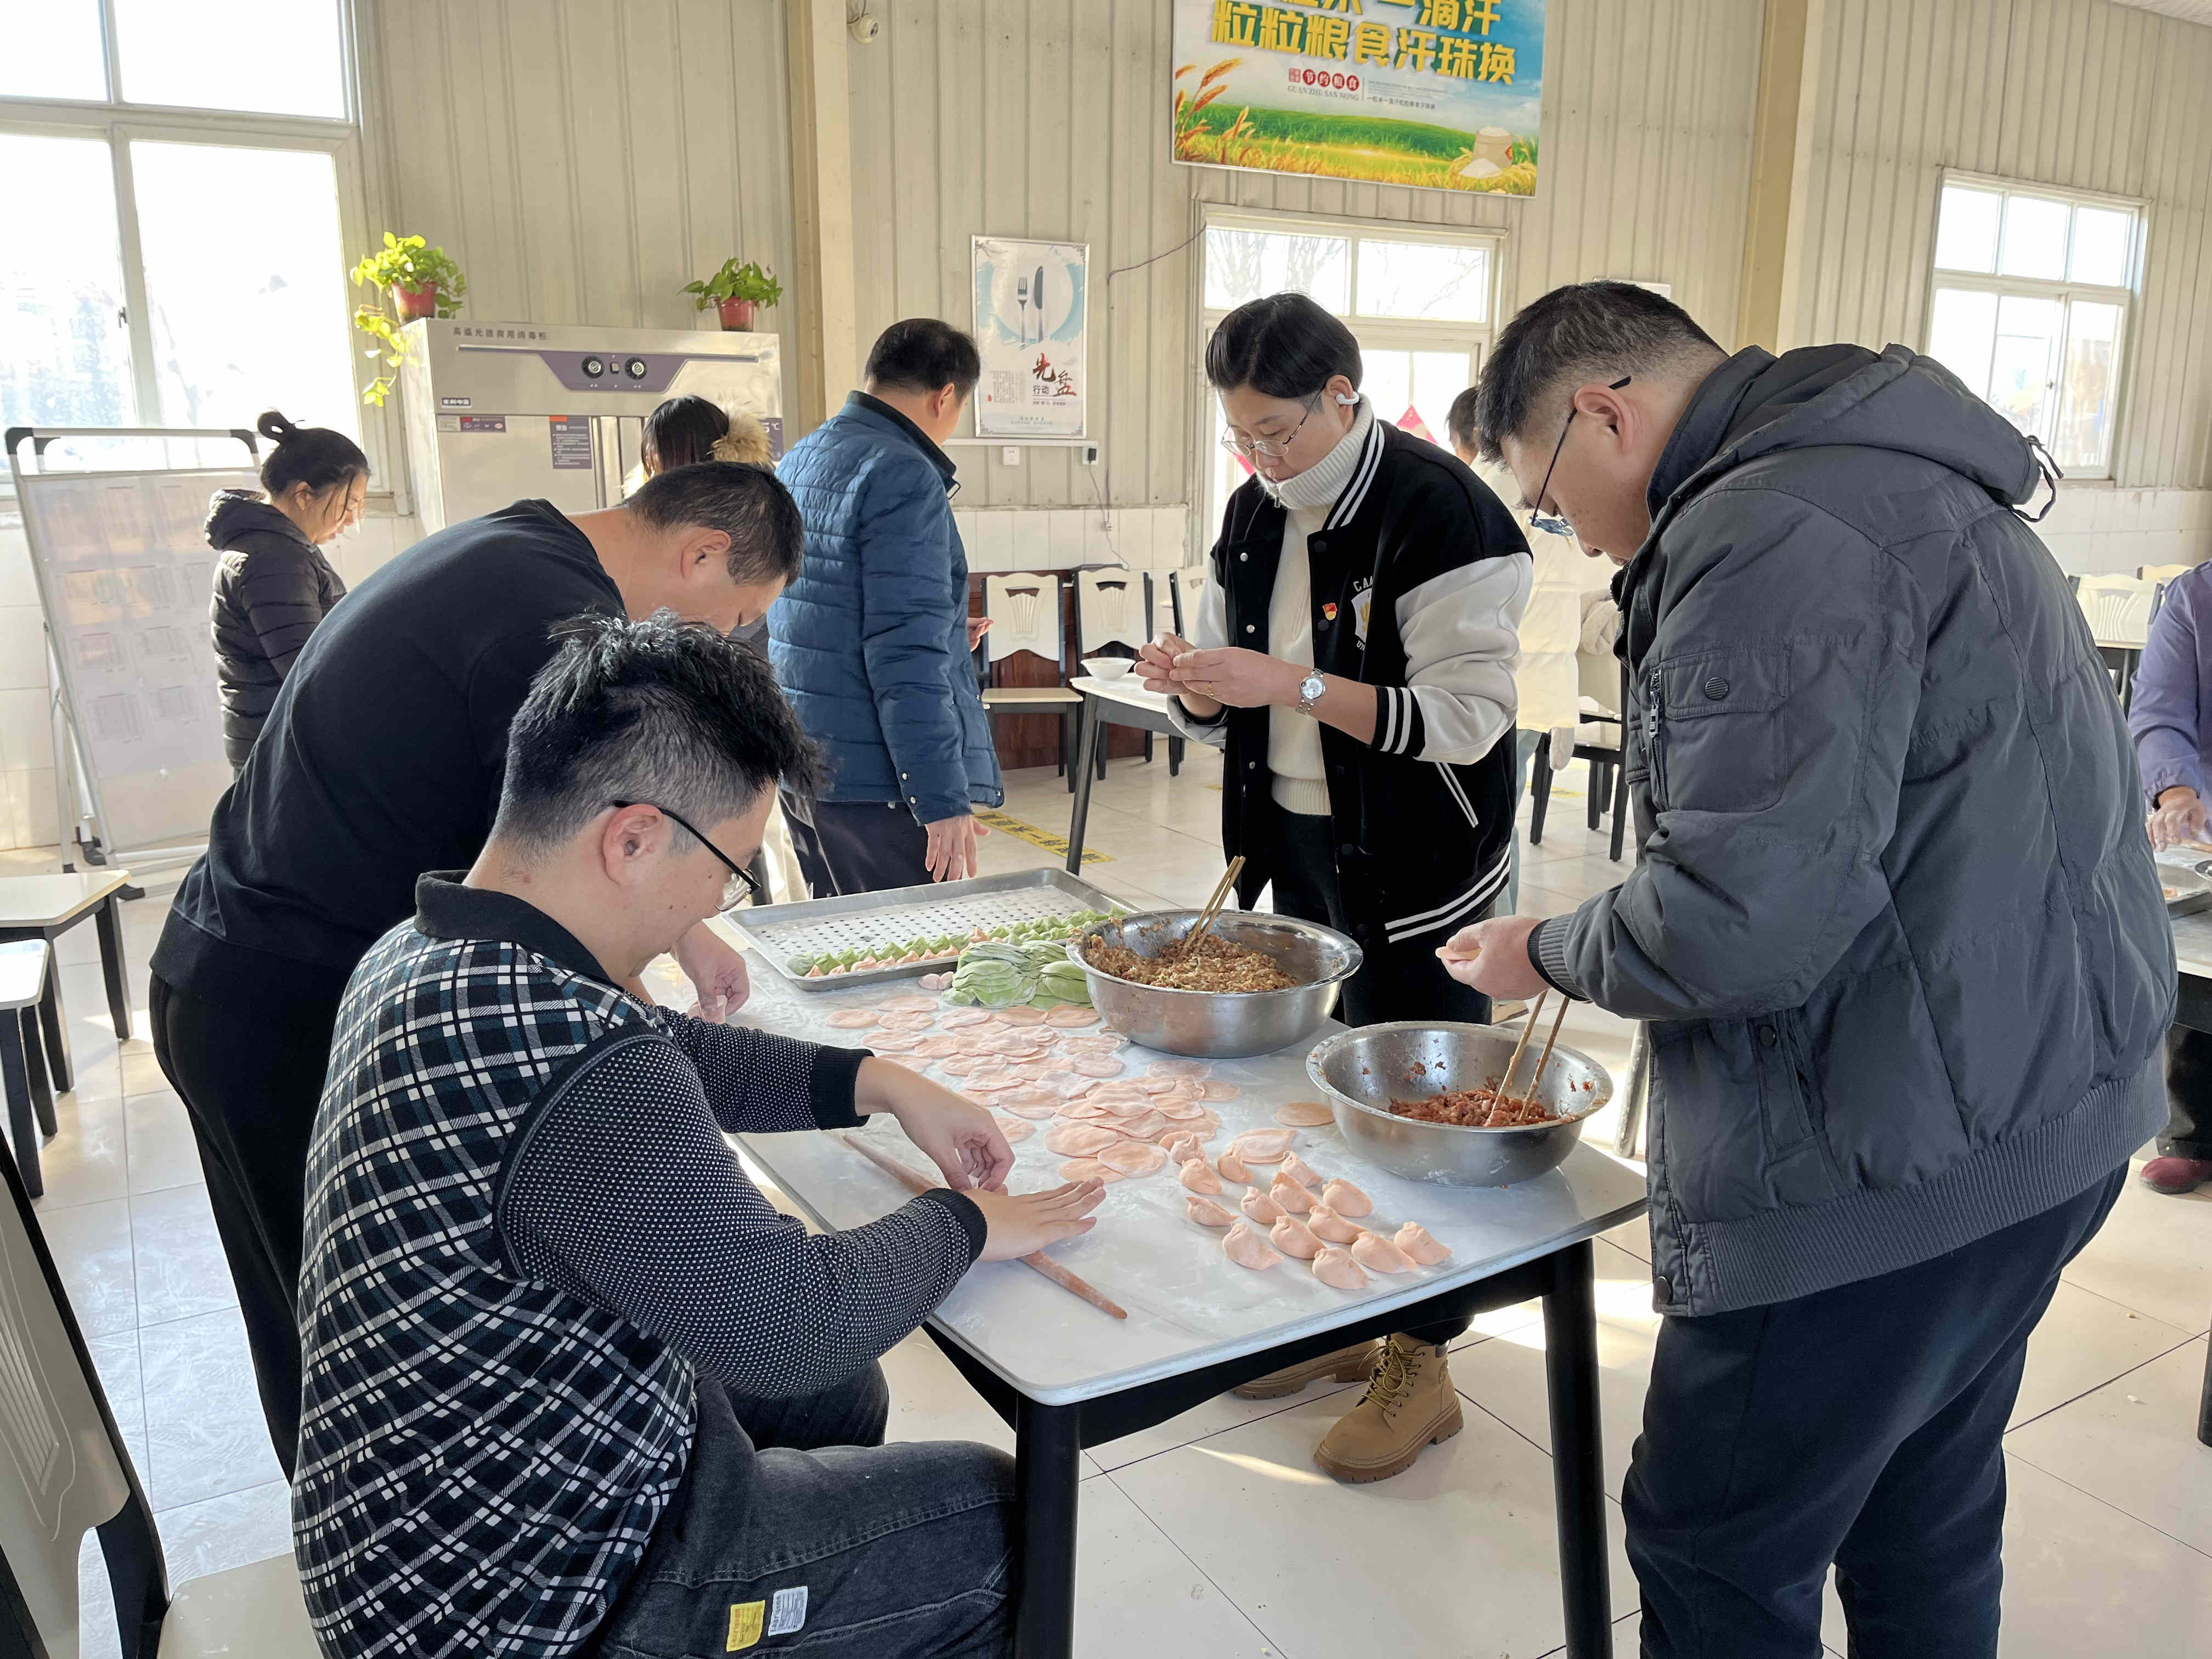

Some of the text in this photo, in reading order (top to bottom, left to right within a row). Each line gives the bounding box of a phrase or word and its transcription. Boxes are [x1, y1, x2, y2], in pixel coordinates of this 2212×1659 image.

[1210, 2, 1516, 85] 粒粒粮食汗珠换
[1303, 69, 1359, 92] 节约粮食
[1288, 85, 1359, 101] GUAN ZHU SAN NONG
[1032, 385, 1049, 394] 行动
